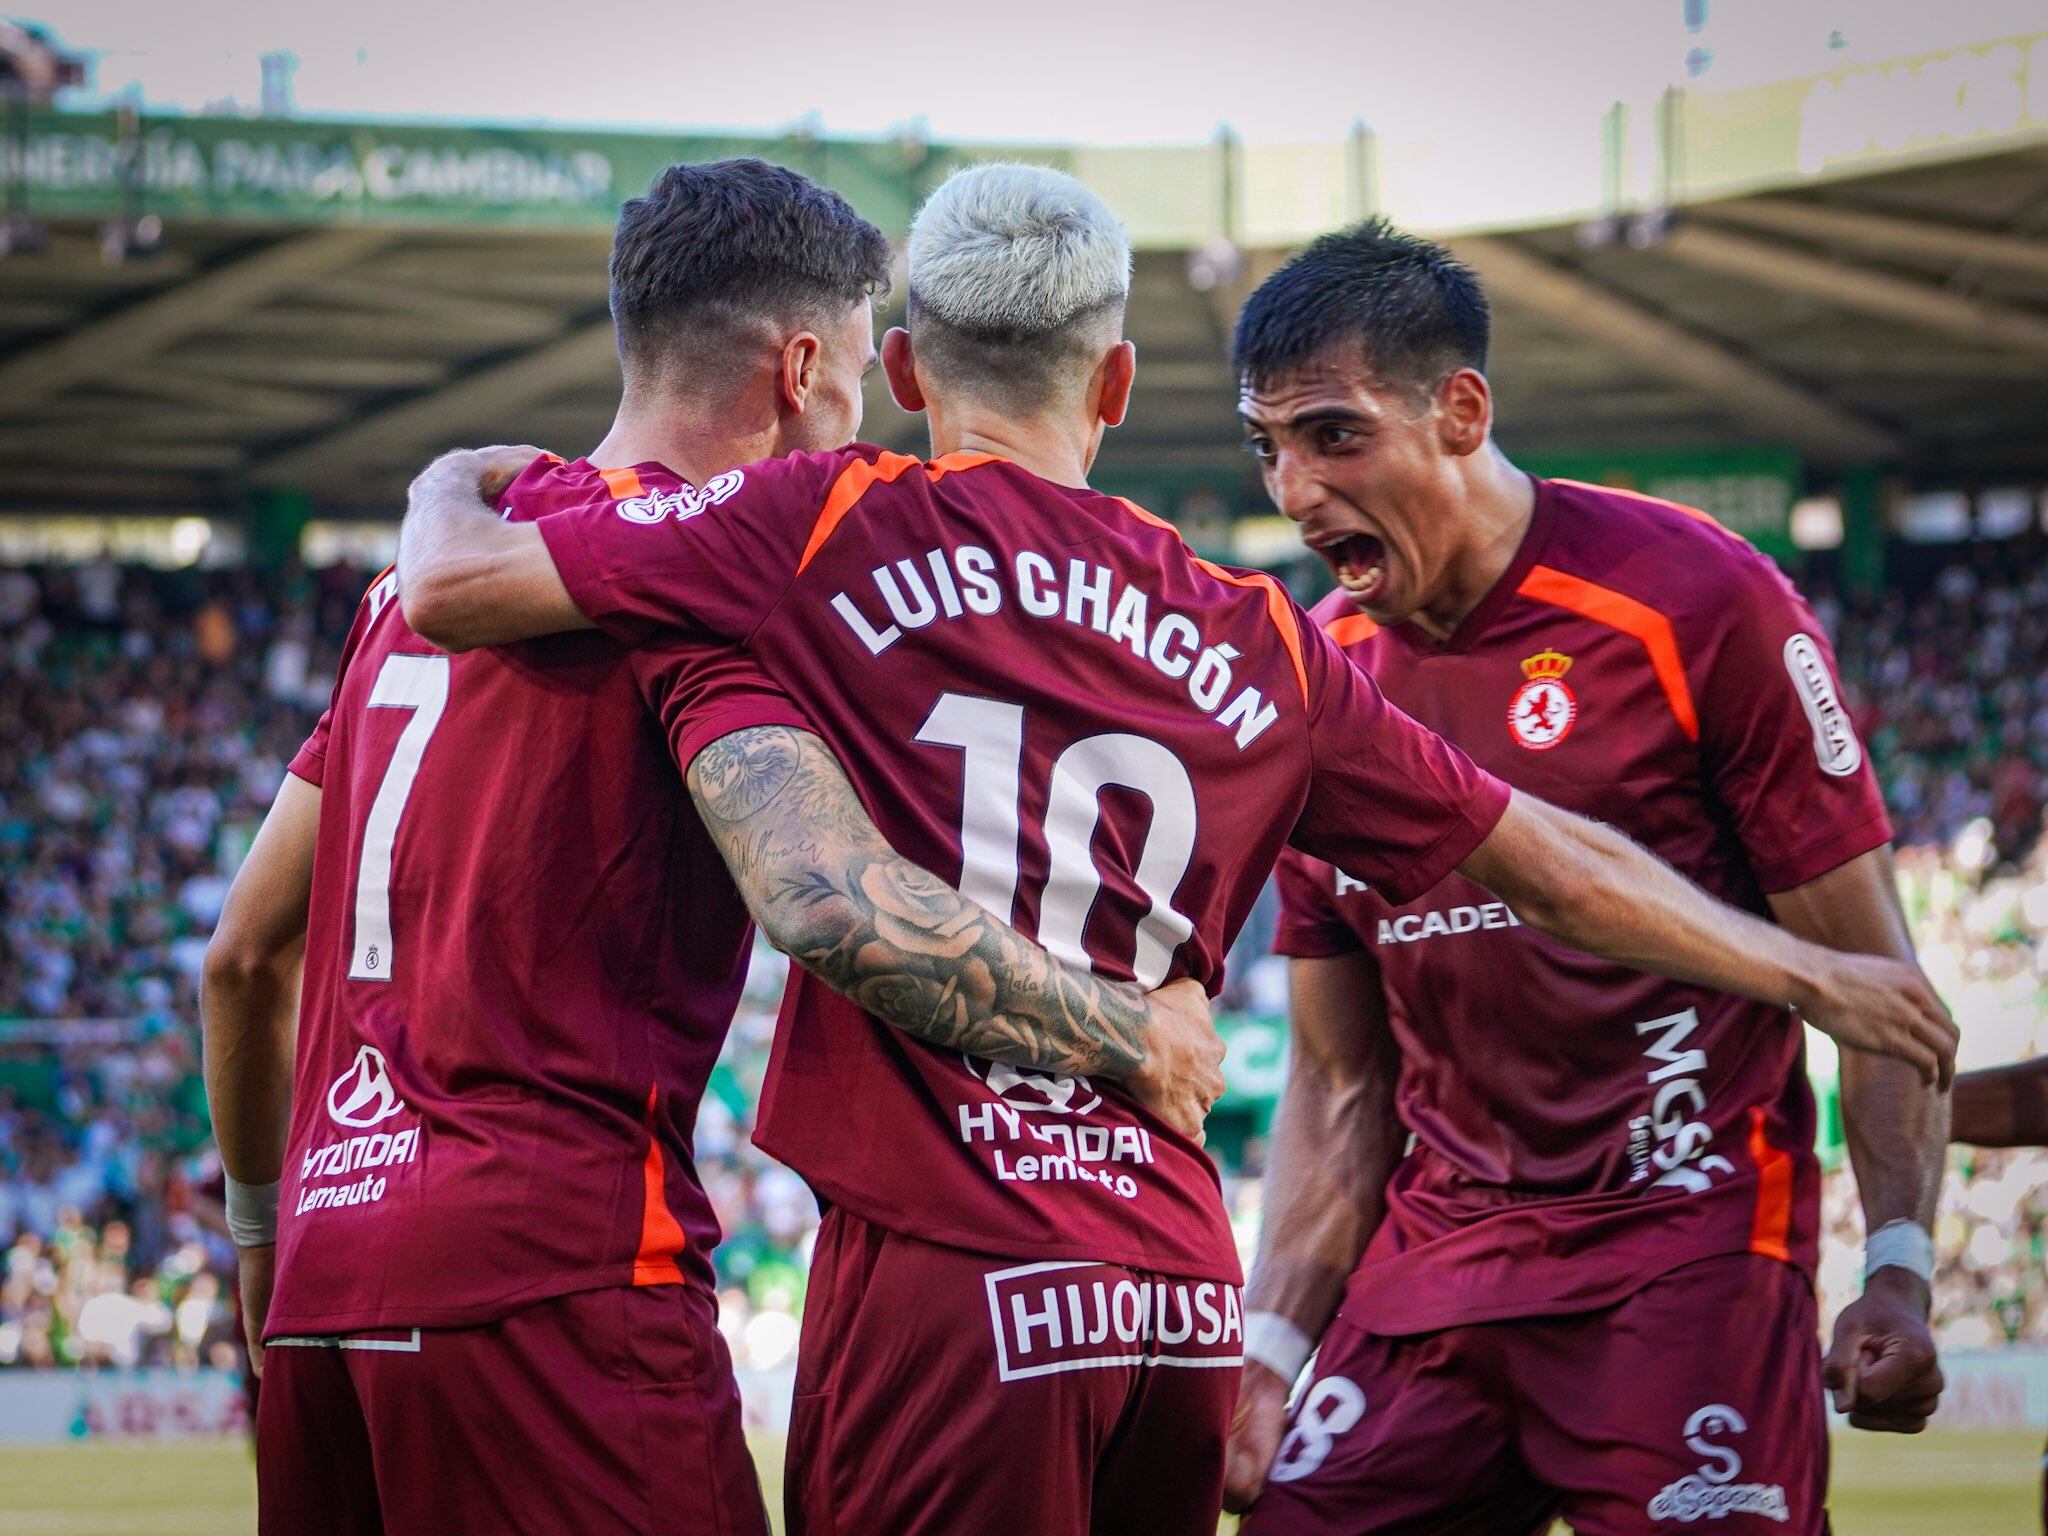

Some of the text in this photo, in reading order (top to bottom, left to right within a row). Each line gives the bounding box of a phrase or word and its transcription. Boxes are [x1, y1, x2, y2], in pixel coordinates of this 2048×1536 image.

[831, 546, 1279, 751] LUIS CHACÓN
[347, 652, 450, 981] 7
[910, 692, 1197, 990] 10
[1377, 902, 1521, 944] ACADE
[295, 1174, 386, 1217] Lemauto
[994, 1149, 1138, 1199] Lemato
